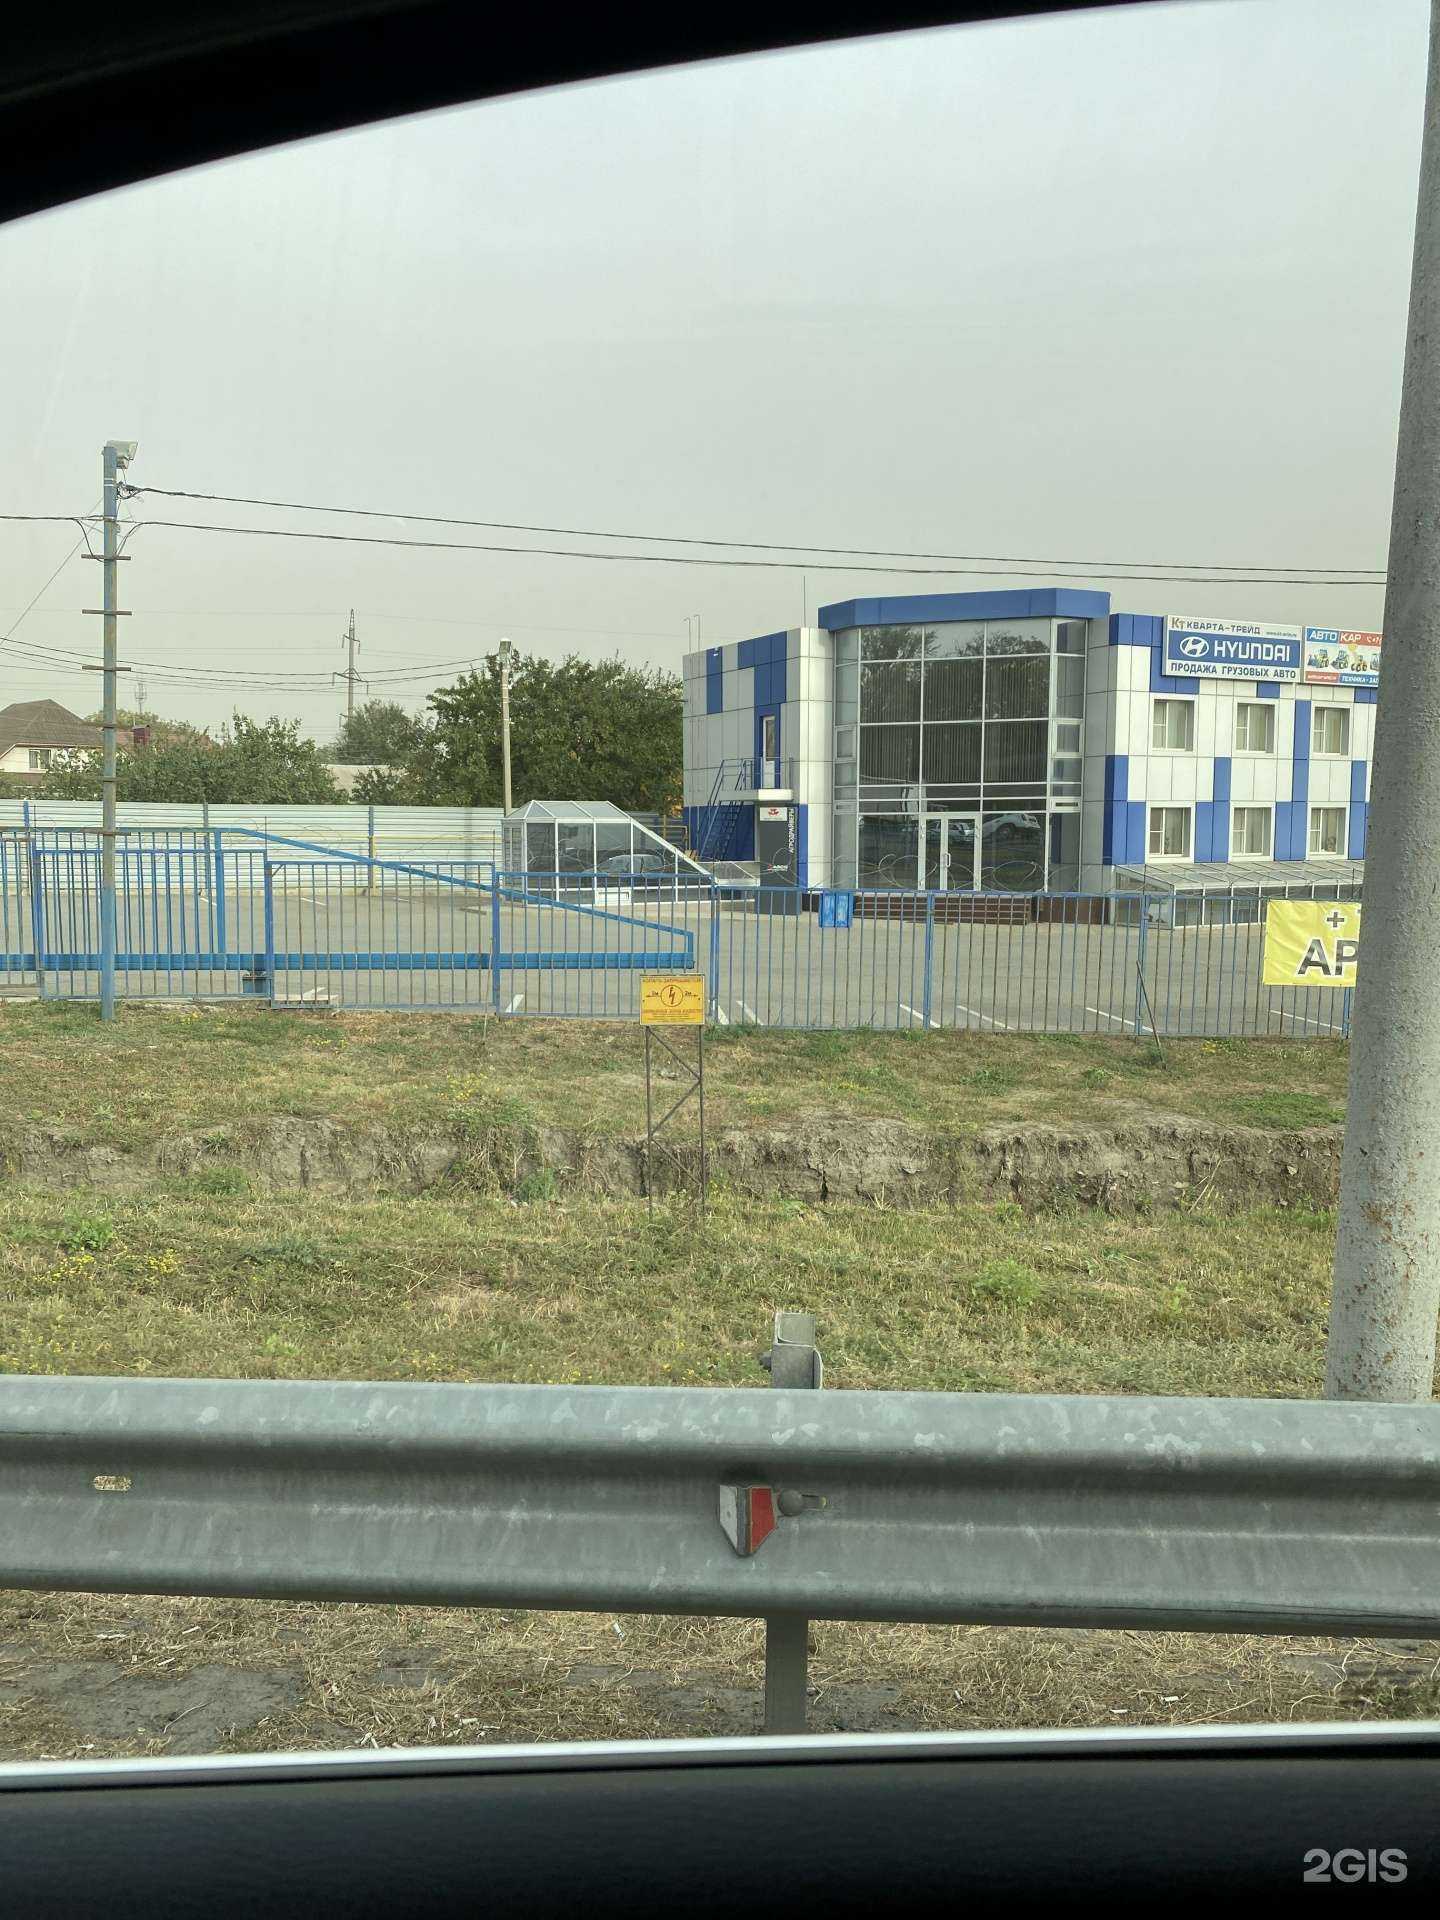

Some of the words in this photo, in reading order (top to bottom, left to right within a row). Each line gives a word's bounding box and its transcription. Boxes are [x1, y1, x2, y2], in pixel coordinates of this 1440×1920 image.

[1186, 620, 1261, 635] КВАРТА-ТРЕЙД
[1309, 630, 1338, 641] АВТО
[1340, 632, 1362, 643] КАР
[1214, 640, 1290, 662] HYUNDAI
[1170, 662, 1218, 676] ПРОДАЖА
[1221, 665, 1269, 677] ГРУЗОВЫХ
[1272, 670, 1297, 679] АВТО
